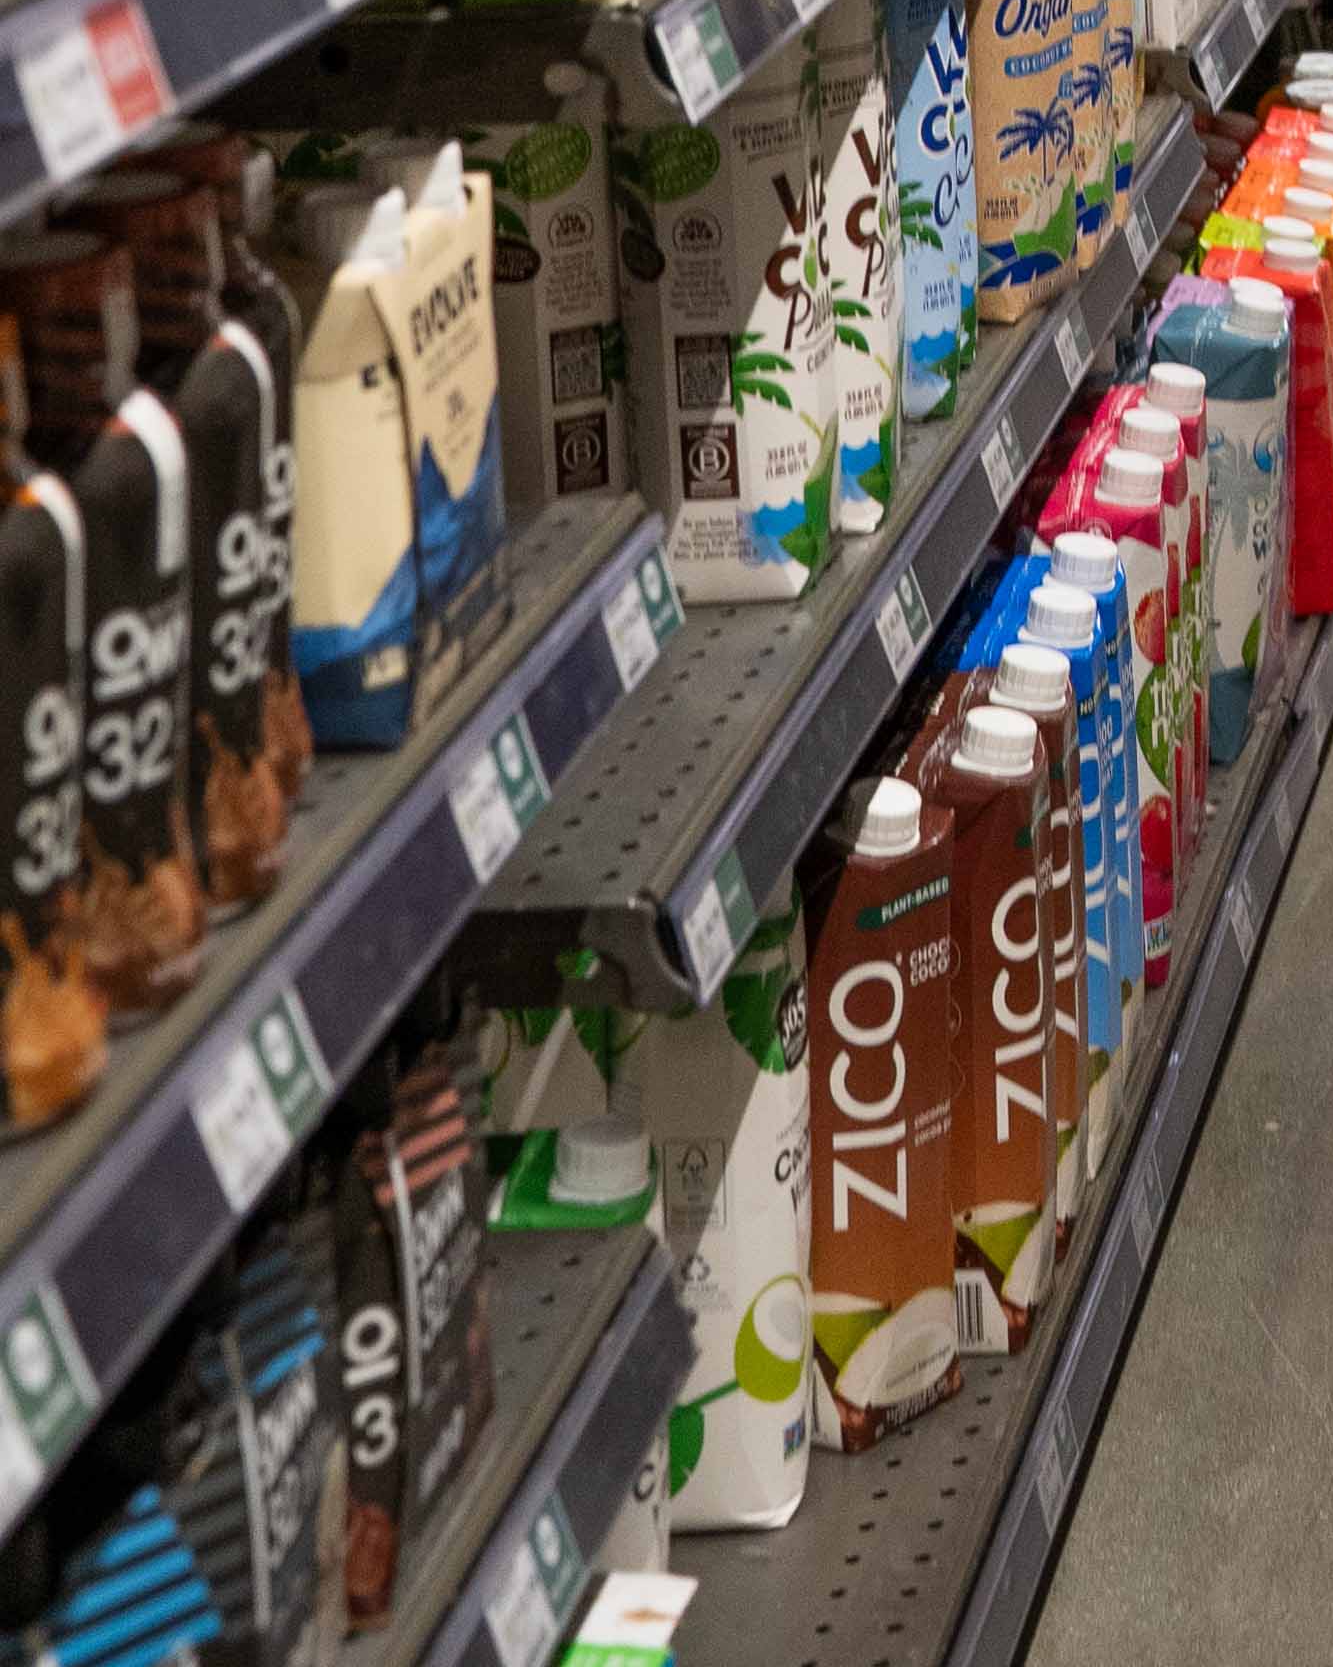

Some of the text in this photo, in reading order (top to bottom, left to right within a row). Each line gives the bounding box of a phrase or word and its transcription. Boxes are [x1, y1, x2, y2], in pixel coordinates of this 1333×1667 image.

[409, 253, 478, 357] EVOLVE
[86, 697, 177, 802] 32
[881, 877, 950, 923] PLANT-BASED
[990, 874, 1047, 1145] ZICO
[828, 960, 908, 1233] ZICO
